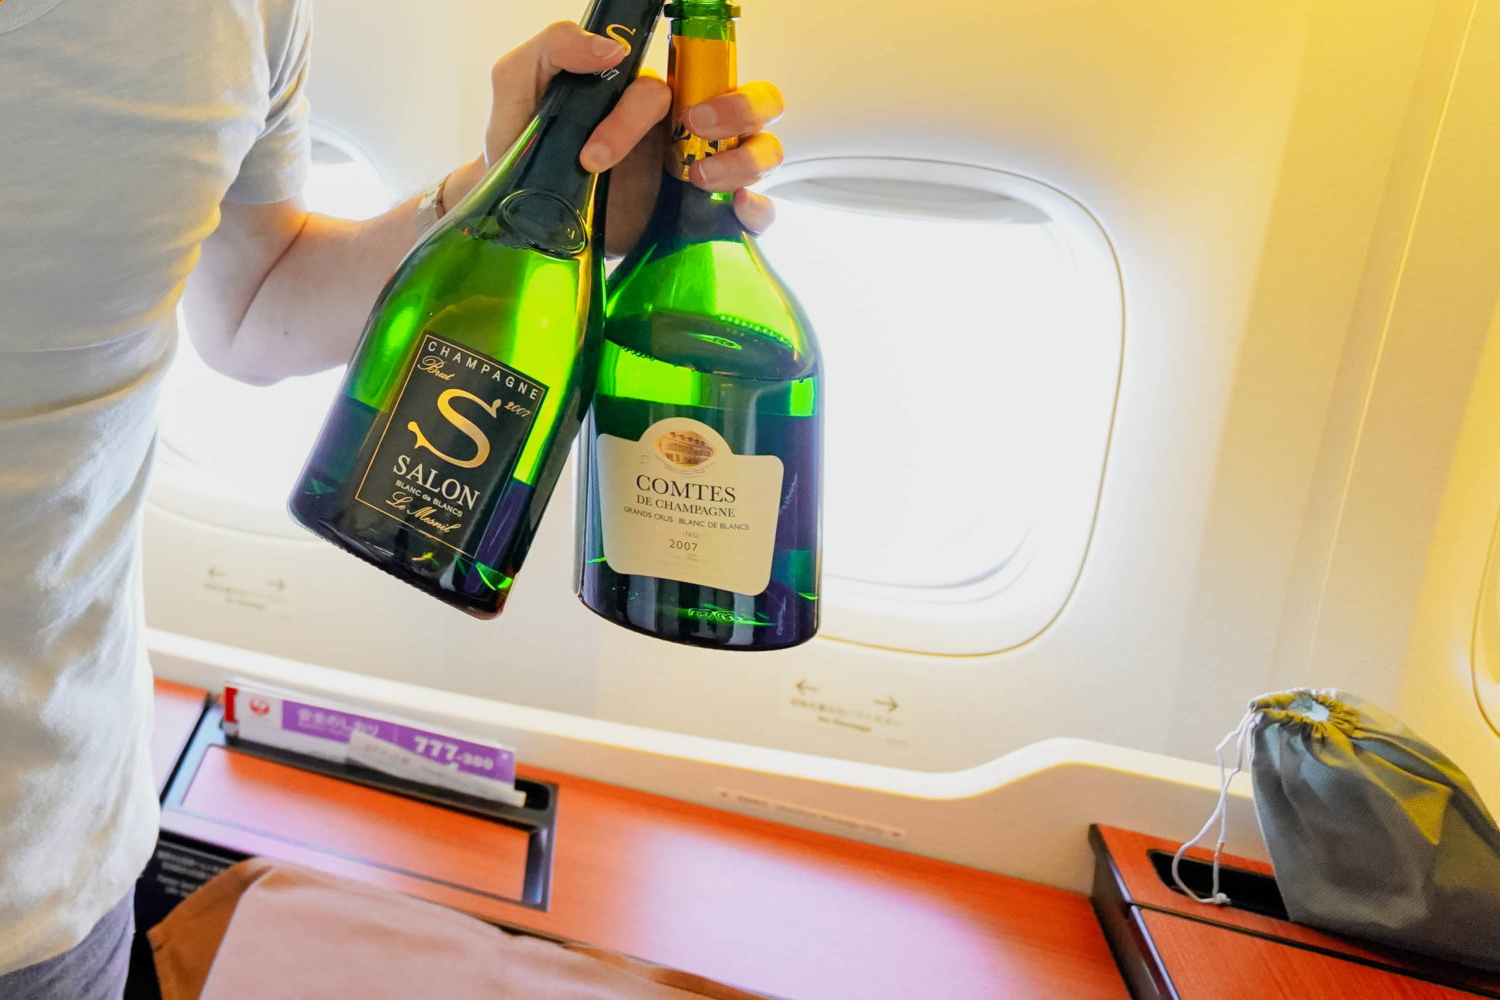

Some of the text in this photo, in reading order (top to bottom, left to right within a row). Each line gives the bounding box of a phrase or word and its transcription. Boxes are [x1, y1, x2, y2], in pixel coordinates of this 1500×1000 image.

[417, 355, 456, 381] Brut
[428, 341, 539, 400] CHAMPAGNE
[504, 401, 531, 418] 2007
[407, 388, 502, 469] S
[393, 454, 481, 511] SALON
[636, 474, 736, 504] COMTES
[395, 480, 463, 518] BLANC de BLANCS
[636, 494, 736, 518] DE CHAMPAGNE
[406, 506, 462, 533] Mesnil
[623, 505, 750, 531] GRANDS CRUS BLANC DE BLANCS
[669, 539, 698, 552] 2007
